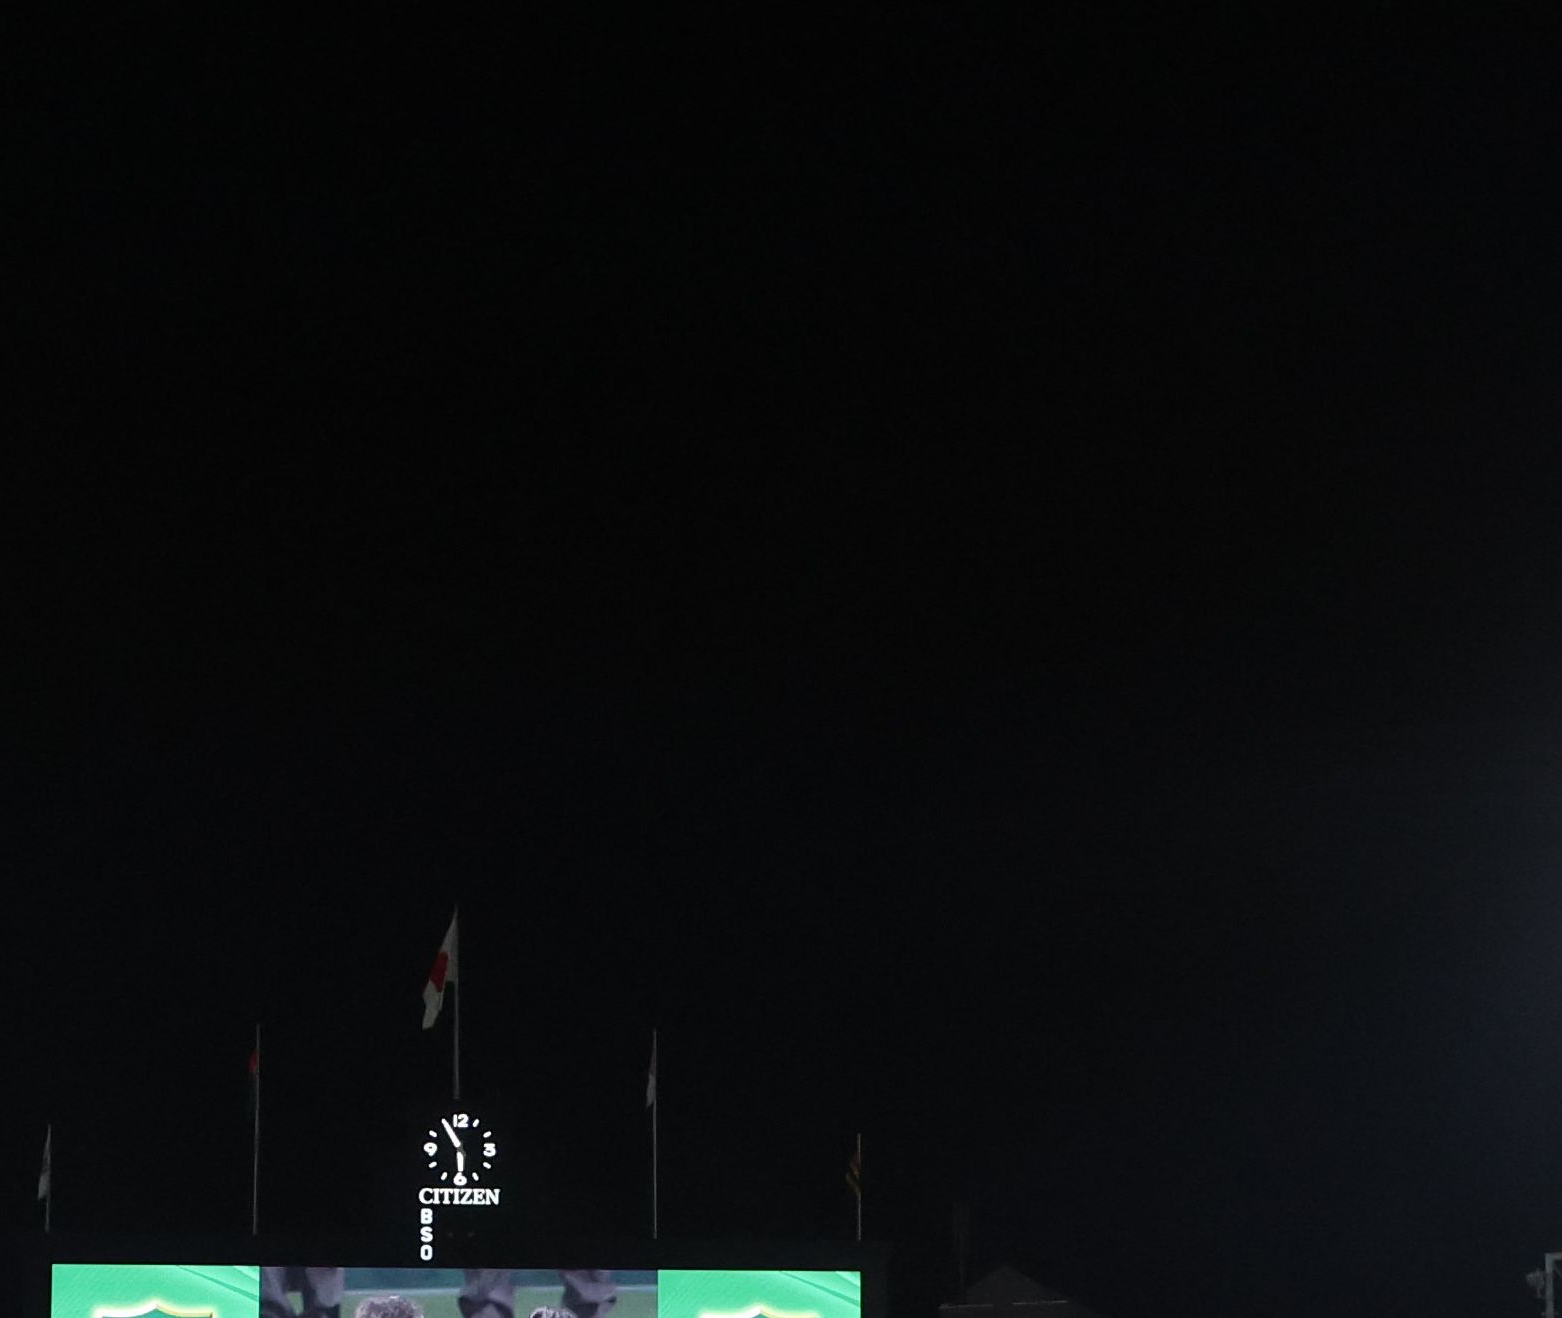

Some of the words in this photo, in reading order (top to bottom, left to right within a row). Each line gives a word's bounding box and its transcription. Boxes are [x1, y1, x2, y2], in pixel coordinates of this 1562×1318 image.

[453, 1113, 469, 1128] 12
[423, 1142, 438, 1157] 9
[483, 1143, 497, 1157] 3
[453, 1172, 468, 1186] 6
[418, 1187, 501, 1205] CITIZEN
[420, 1208, 433, 1225] B
[420, 1226, 433, 1243] S
